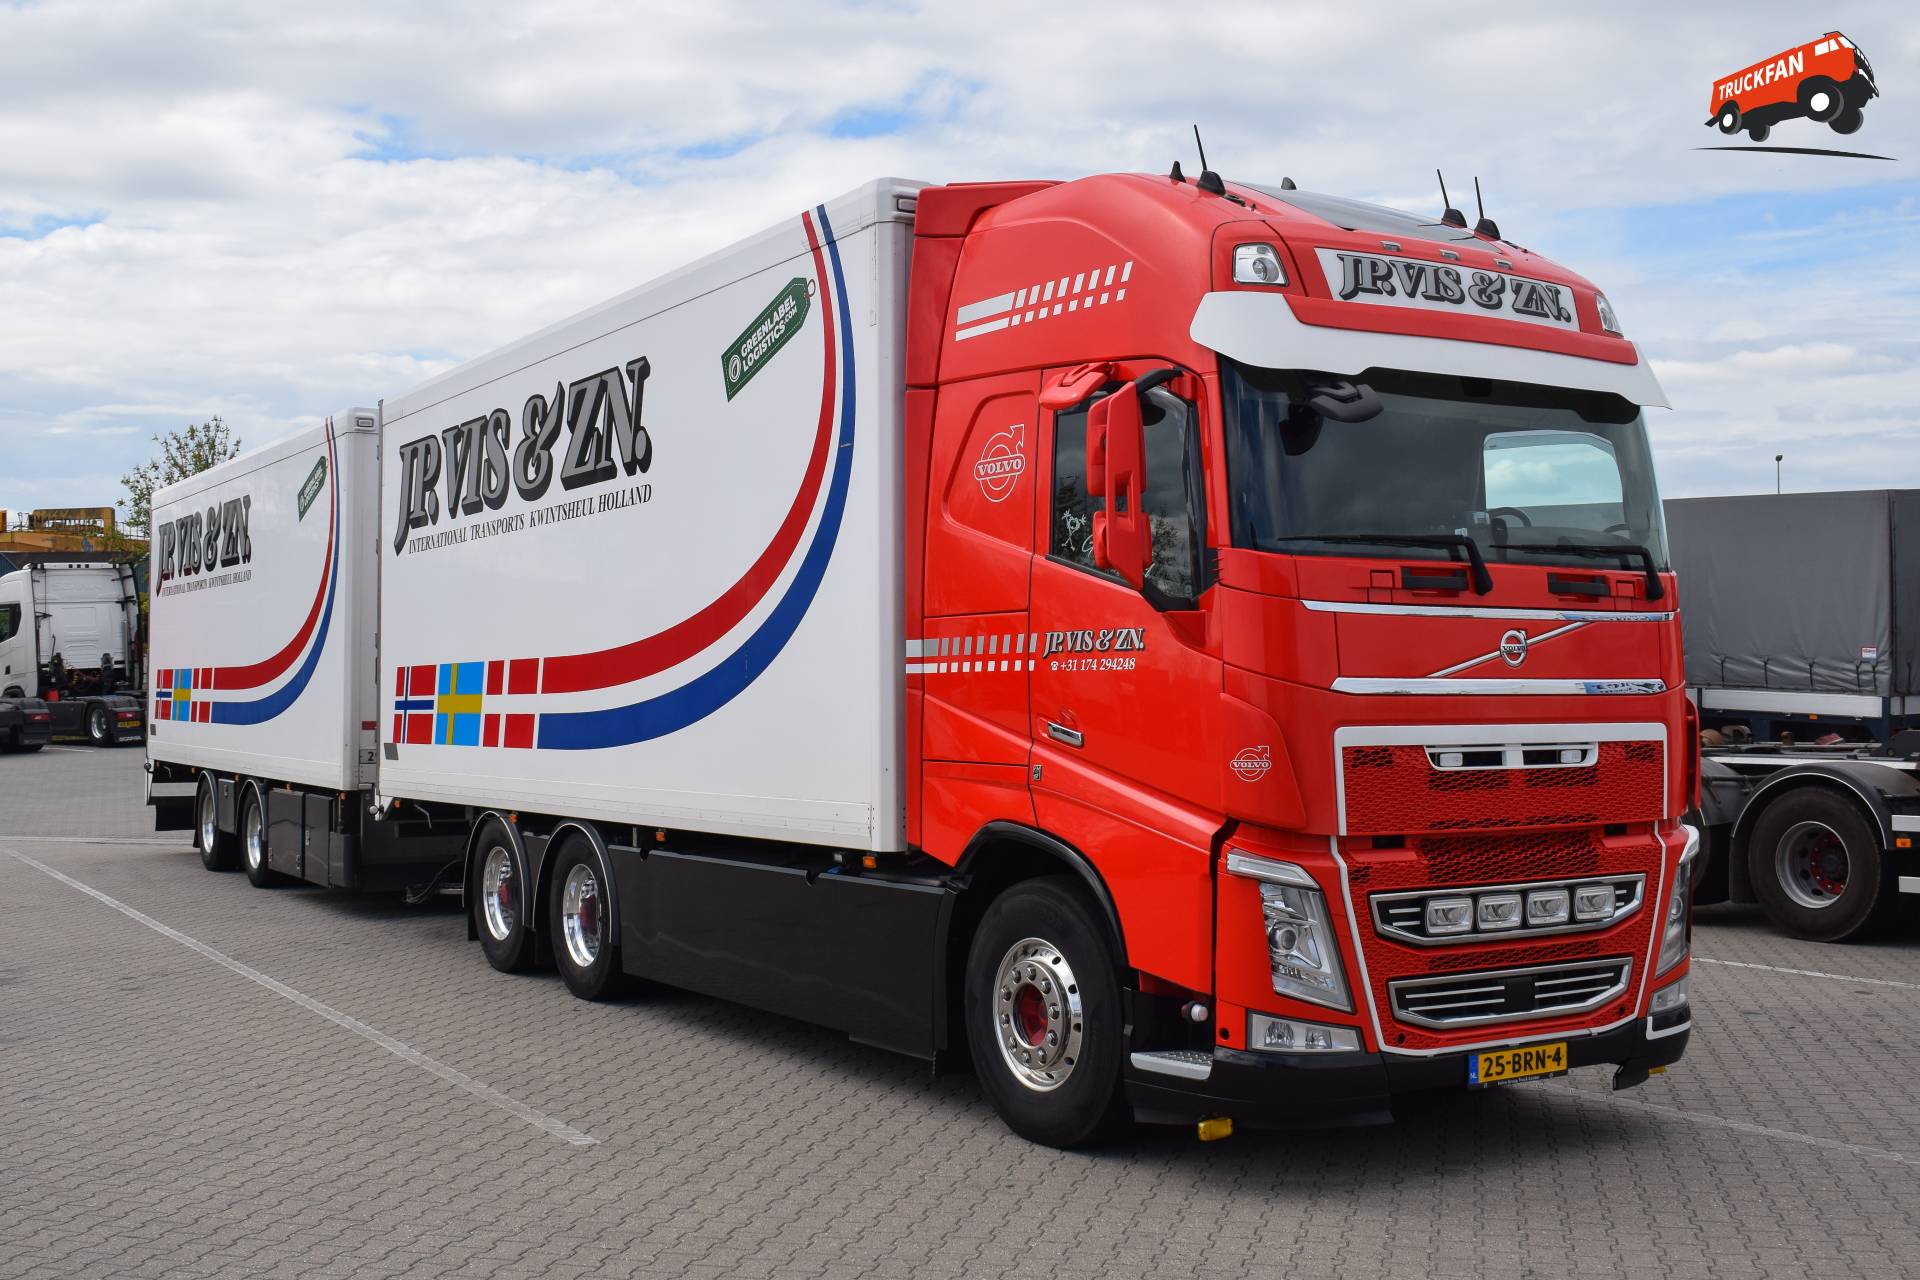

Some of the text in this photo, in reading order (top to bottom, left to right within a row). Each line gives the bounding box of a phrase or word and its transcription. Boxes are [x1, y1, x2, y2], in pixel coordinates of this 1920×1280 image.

[1389, 259, 1465, 304] VIS
[1468, 271, 1506, 310] &
[1510, 278, 1572, 323] ZN.
[741, 295, 796, 358] GREENLABEL
[442, 408, 511, 520] VIS
[513, 380, 565, 501] &
[560, 355, 653, 491] ZN.
[977, 459, 1022, 476] VOLVO
[176, 511, 202, 578] VIS
[203, 501, 222, 572] &
[408, 484, 653, 555] INTERNATIONAL TRANSPORTS KWINTSHEUL HOLLAND
[1060, 657, 1136, 671] +31 174 294248
[1065, 629, 1095, 653] VIS
[1095, 627, 1115, 652] &
[1114, 627, 1146, 652] ZN.
[1483, 1046, 1562, 1078] 25-BRN-4
